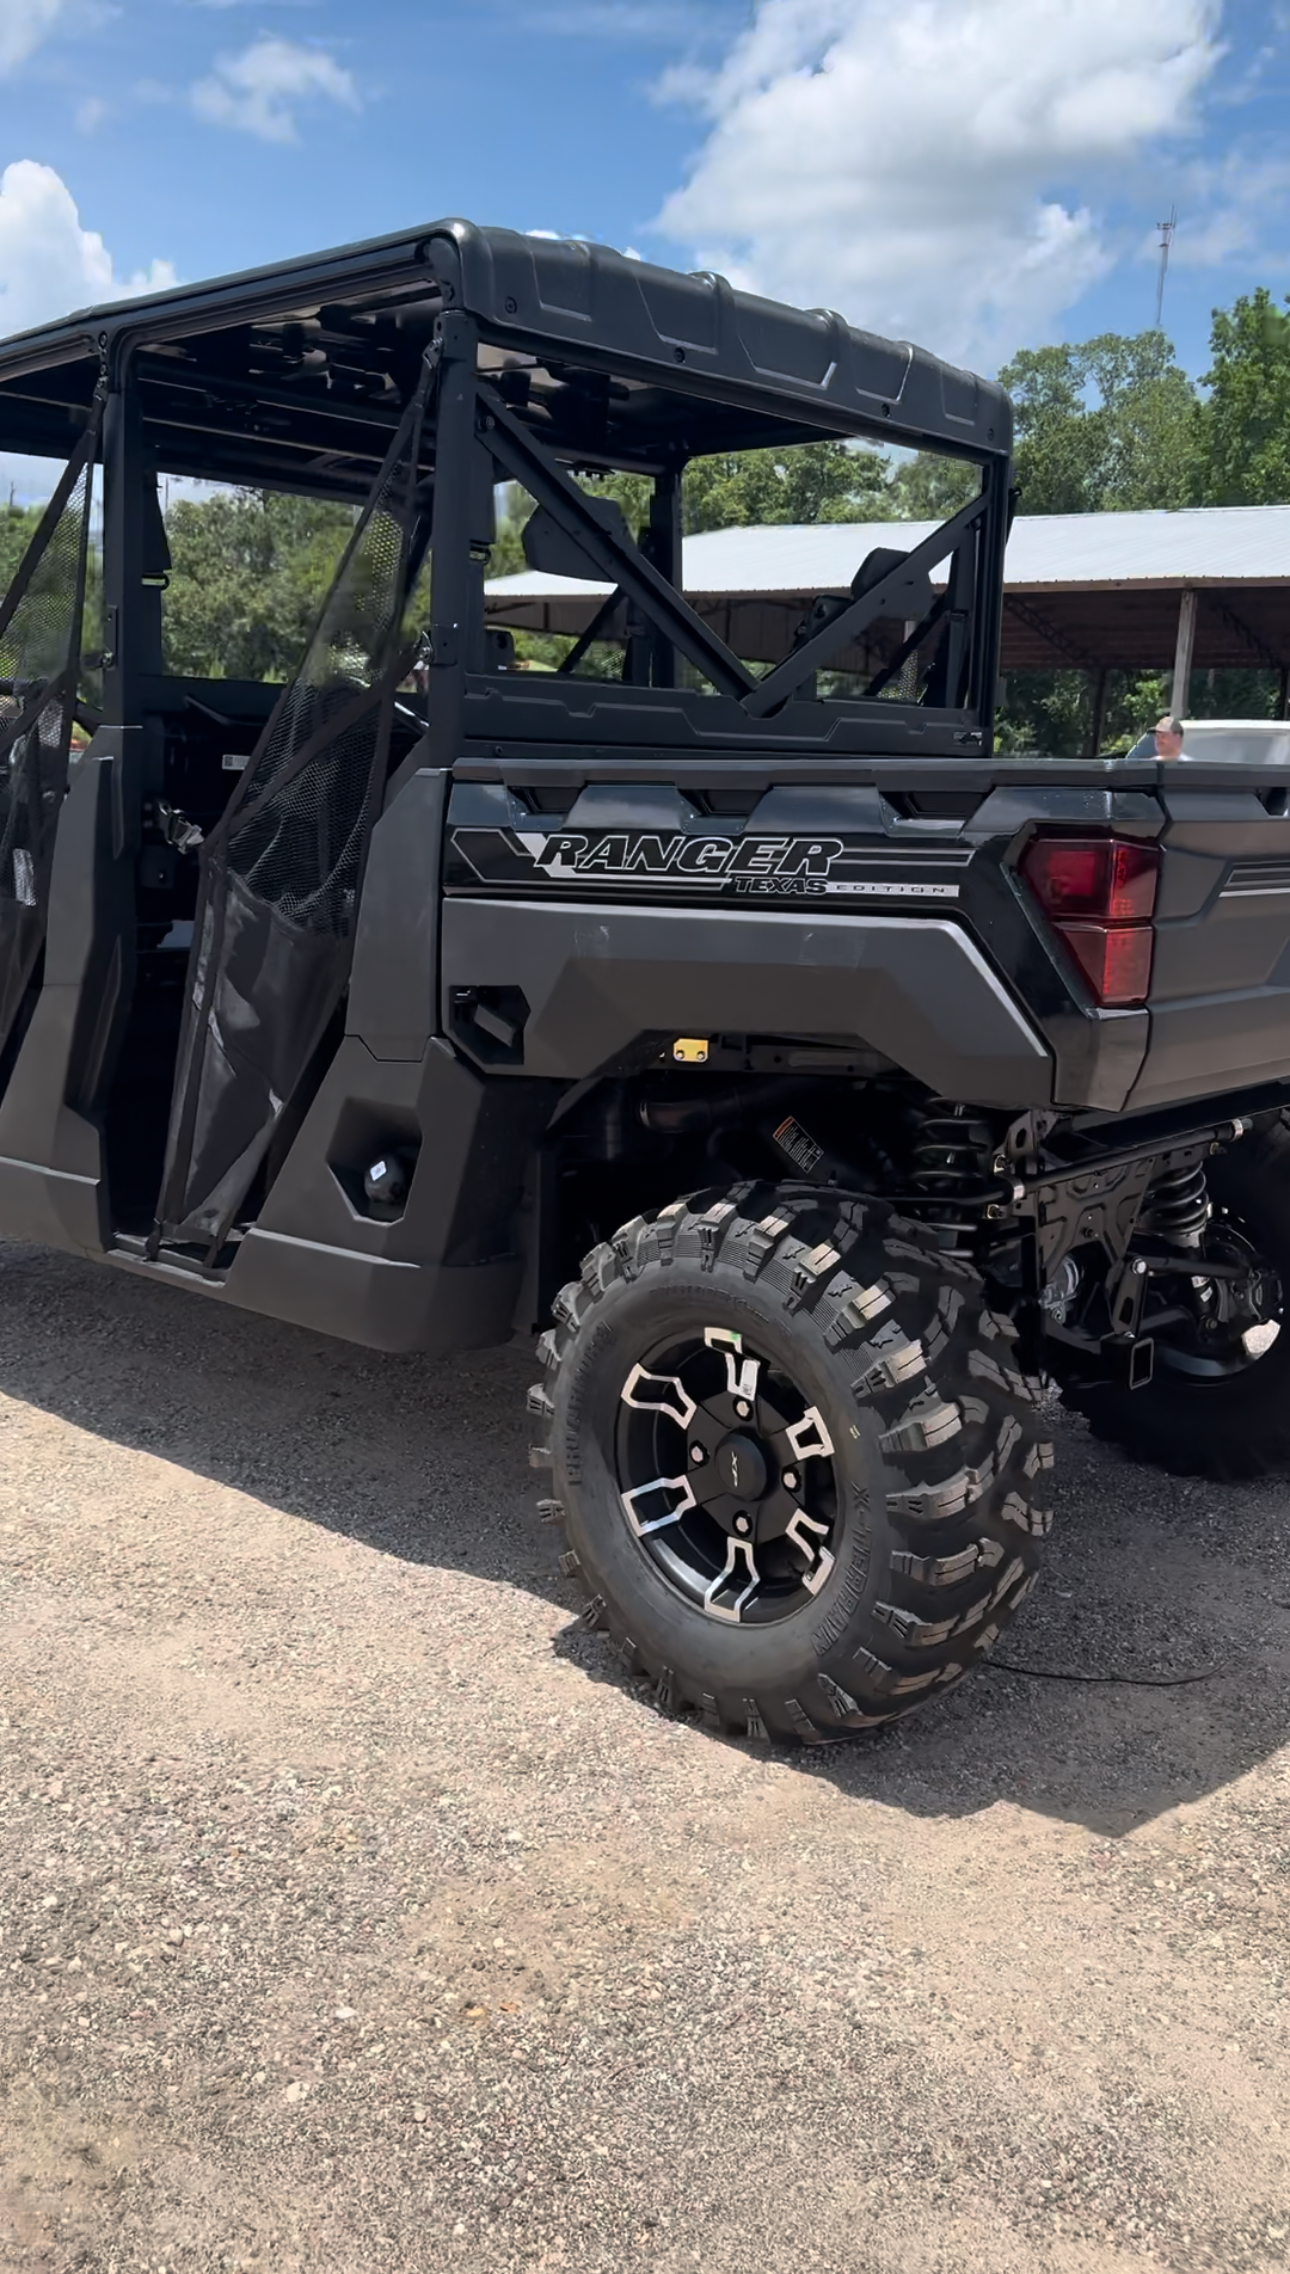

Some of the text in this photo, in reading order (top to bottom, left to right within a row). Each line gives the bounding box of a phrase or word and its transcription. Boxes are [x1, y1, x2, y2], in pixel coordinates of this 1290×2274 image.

[534, 834, 844, 875] RANGER
[734, 876, 945, 896] TEXAS EDITION
